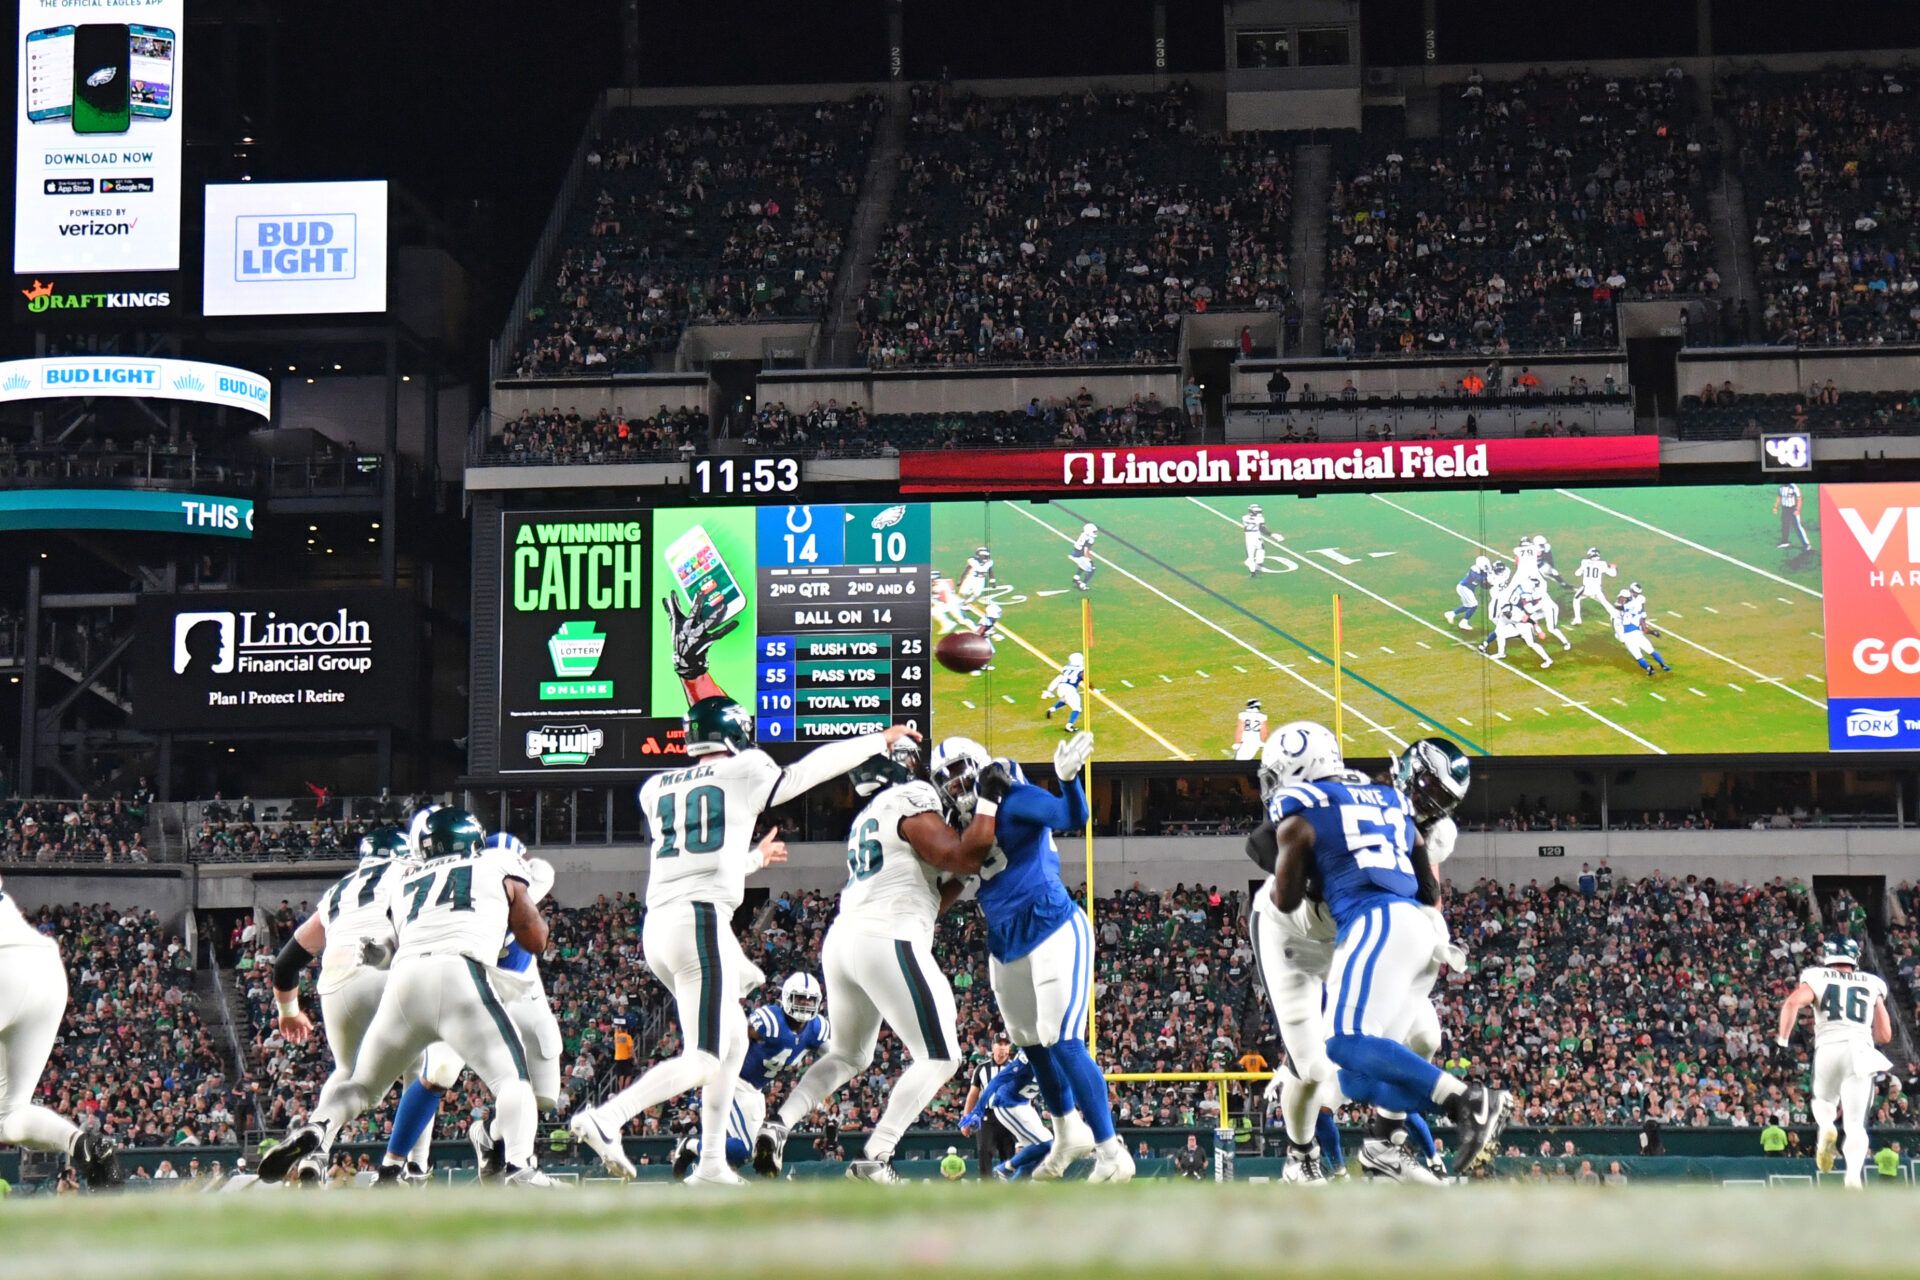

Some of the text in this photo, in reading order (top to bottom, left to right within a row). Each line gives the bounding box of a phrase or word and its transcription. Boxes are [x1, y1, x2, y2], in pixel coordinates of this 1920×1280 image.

[1156, 38, 1166, 68] 236
[1426, 29, 1436, 60] 235
[891, 47, 901, 76] 237
[45, 152, 153, 165] DOWNLOAD NOW
[58, 184, 92, 193] App Store
[115, 183, 151, 192] Google Play
[70, 208, 127, 217] POWERED BY
[59, 220, 128, 236] verizon
[258, 221, 334, 247] BUD
[242, 248, 348, 274] LIGHT
[27, 292, 170, 313] DRAFTKINGS
[46, 368, 156, 384] BUD LIGHT
[219, 377, 247, 395] BUD
[1101, 443, 1488, 484] Lincoln Financial Field
[697, 458, 798, 493] 11:53
[181, 501, 239, 529] THIS
[516, 522, 641, 544] A WINNING
[784, 533, 818, 563] 14
[872, 532, 906, 562] 10
[514, 544, 641, 611] CATCH
[770, 583, 830, 598] 2ND QTR
[848, 581, 915, 595] 2ND AND 6
[795, 609, 892, 624] BALL ON 14
[239, 608, 372, 646] Lincoln
[560, 647, 600, 655] LOTTERY
[766, 640, 922, 657] 55 RUSH YDS 25
[238, 655, 372, 673] Financial Group
[766, 666, 922, 683] 55 PASS YDS 43
[209, 689, 345, 705] Plan Protect Retire
[546, 684, 607, 695] ONLINE
[762, 693, 922, 710] 110 TOTAL YDS 68
[770, 722, 782, 736] 0
[804, 722, 884, 736] TURNOVERS
[1851, 720, 1893, 732] TORK
[656, 785, 725, 859] 10
[1541, 847, 1562, 856] 129
[328, 861, 393, 925] 77
[403, 865, 477, 925] 74
[1823, 971, 1867, 982] ARNOLD
[1821, 983, 1871, 1024] 46
